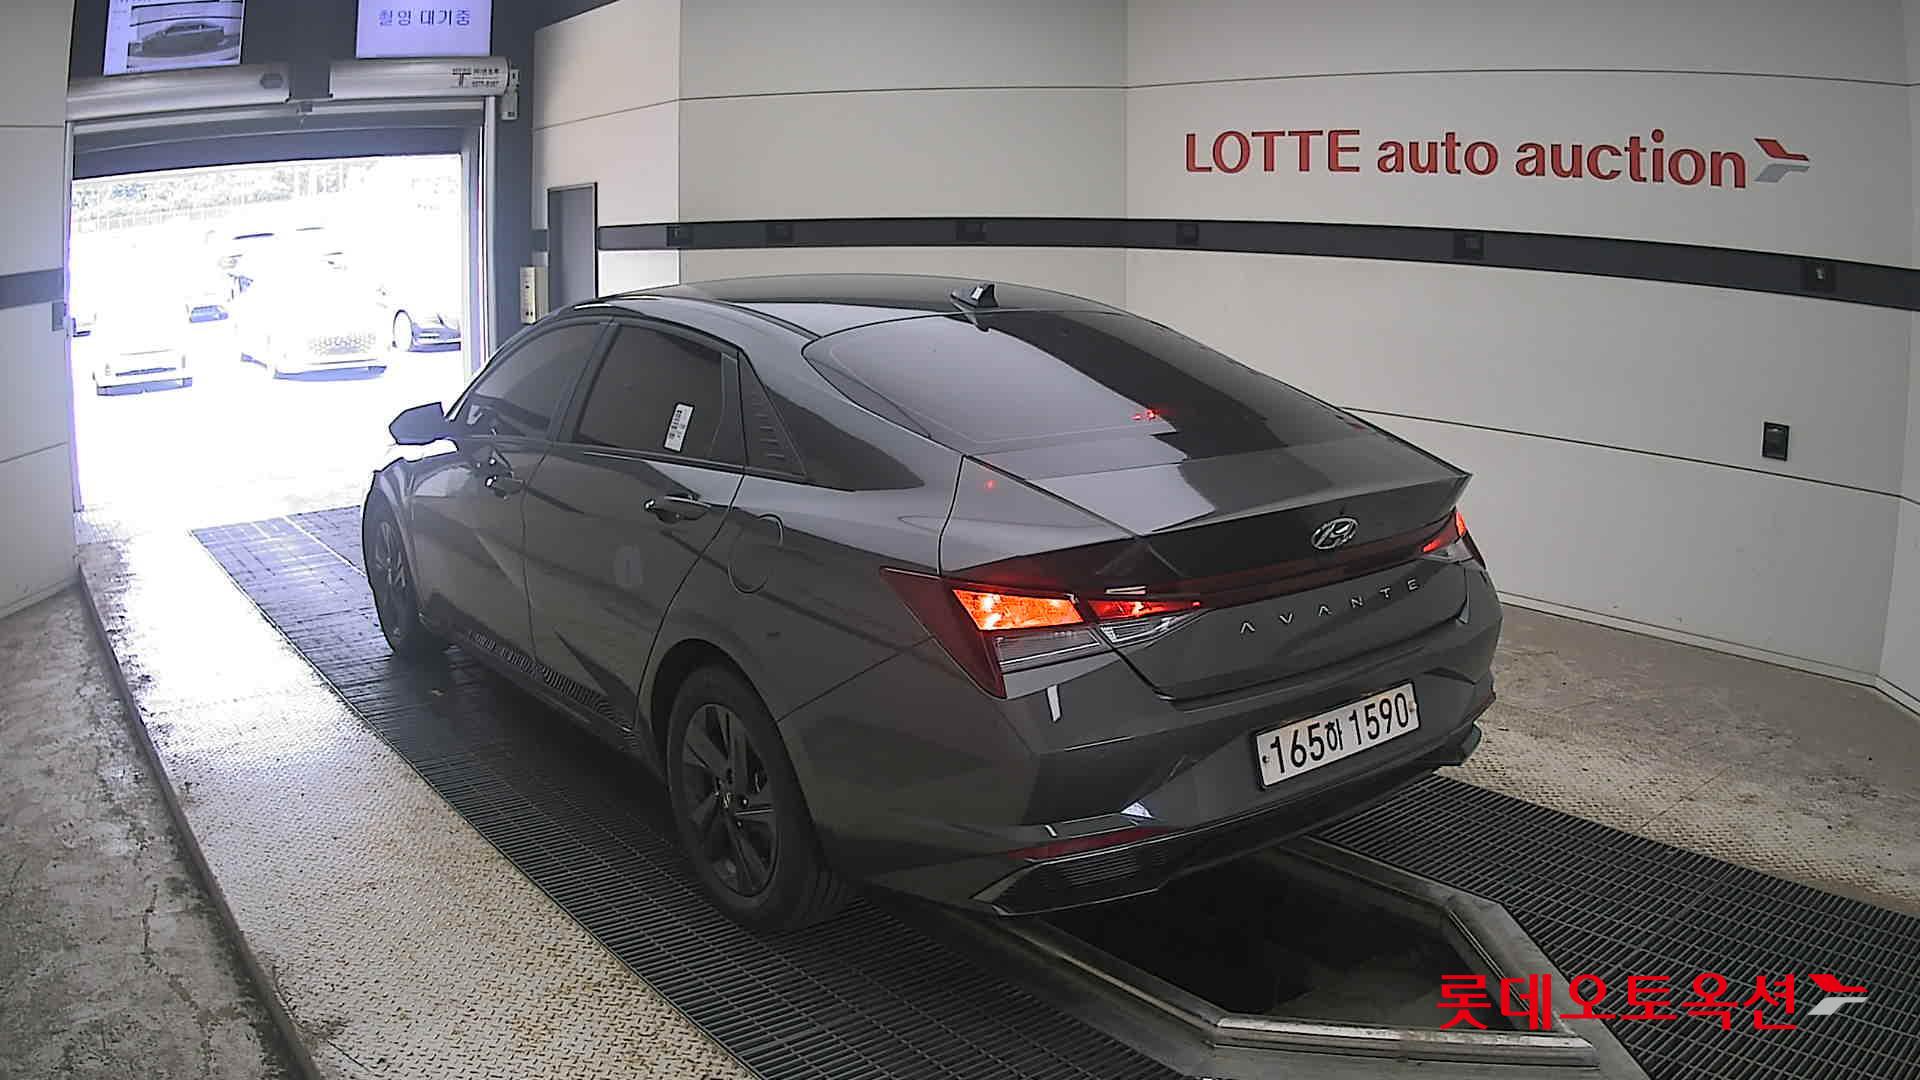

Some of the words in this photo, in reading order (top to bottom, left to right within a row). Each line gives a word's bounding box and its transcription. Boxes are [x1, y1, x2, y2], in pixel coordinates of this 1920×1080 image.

[420, 9, 471, 26] 대기중
[1185, 129, 1361, 173] LOTTE
[1377, 132, 1498, 176] auto
[1515, 129, 1746, 188] auction
[1239, 577, 1420, 634] AVANTE
[1270, 717, 1344, 774] 165하
[1348, 692, 1410, 745] 1590
